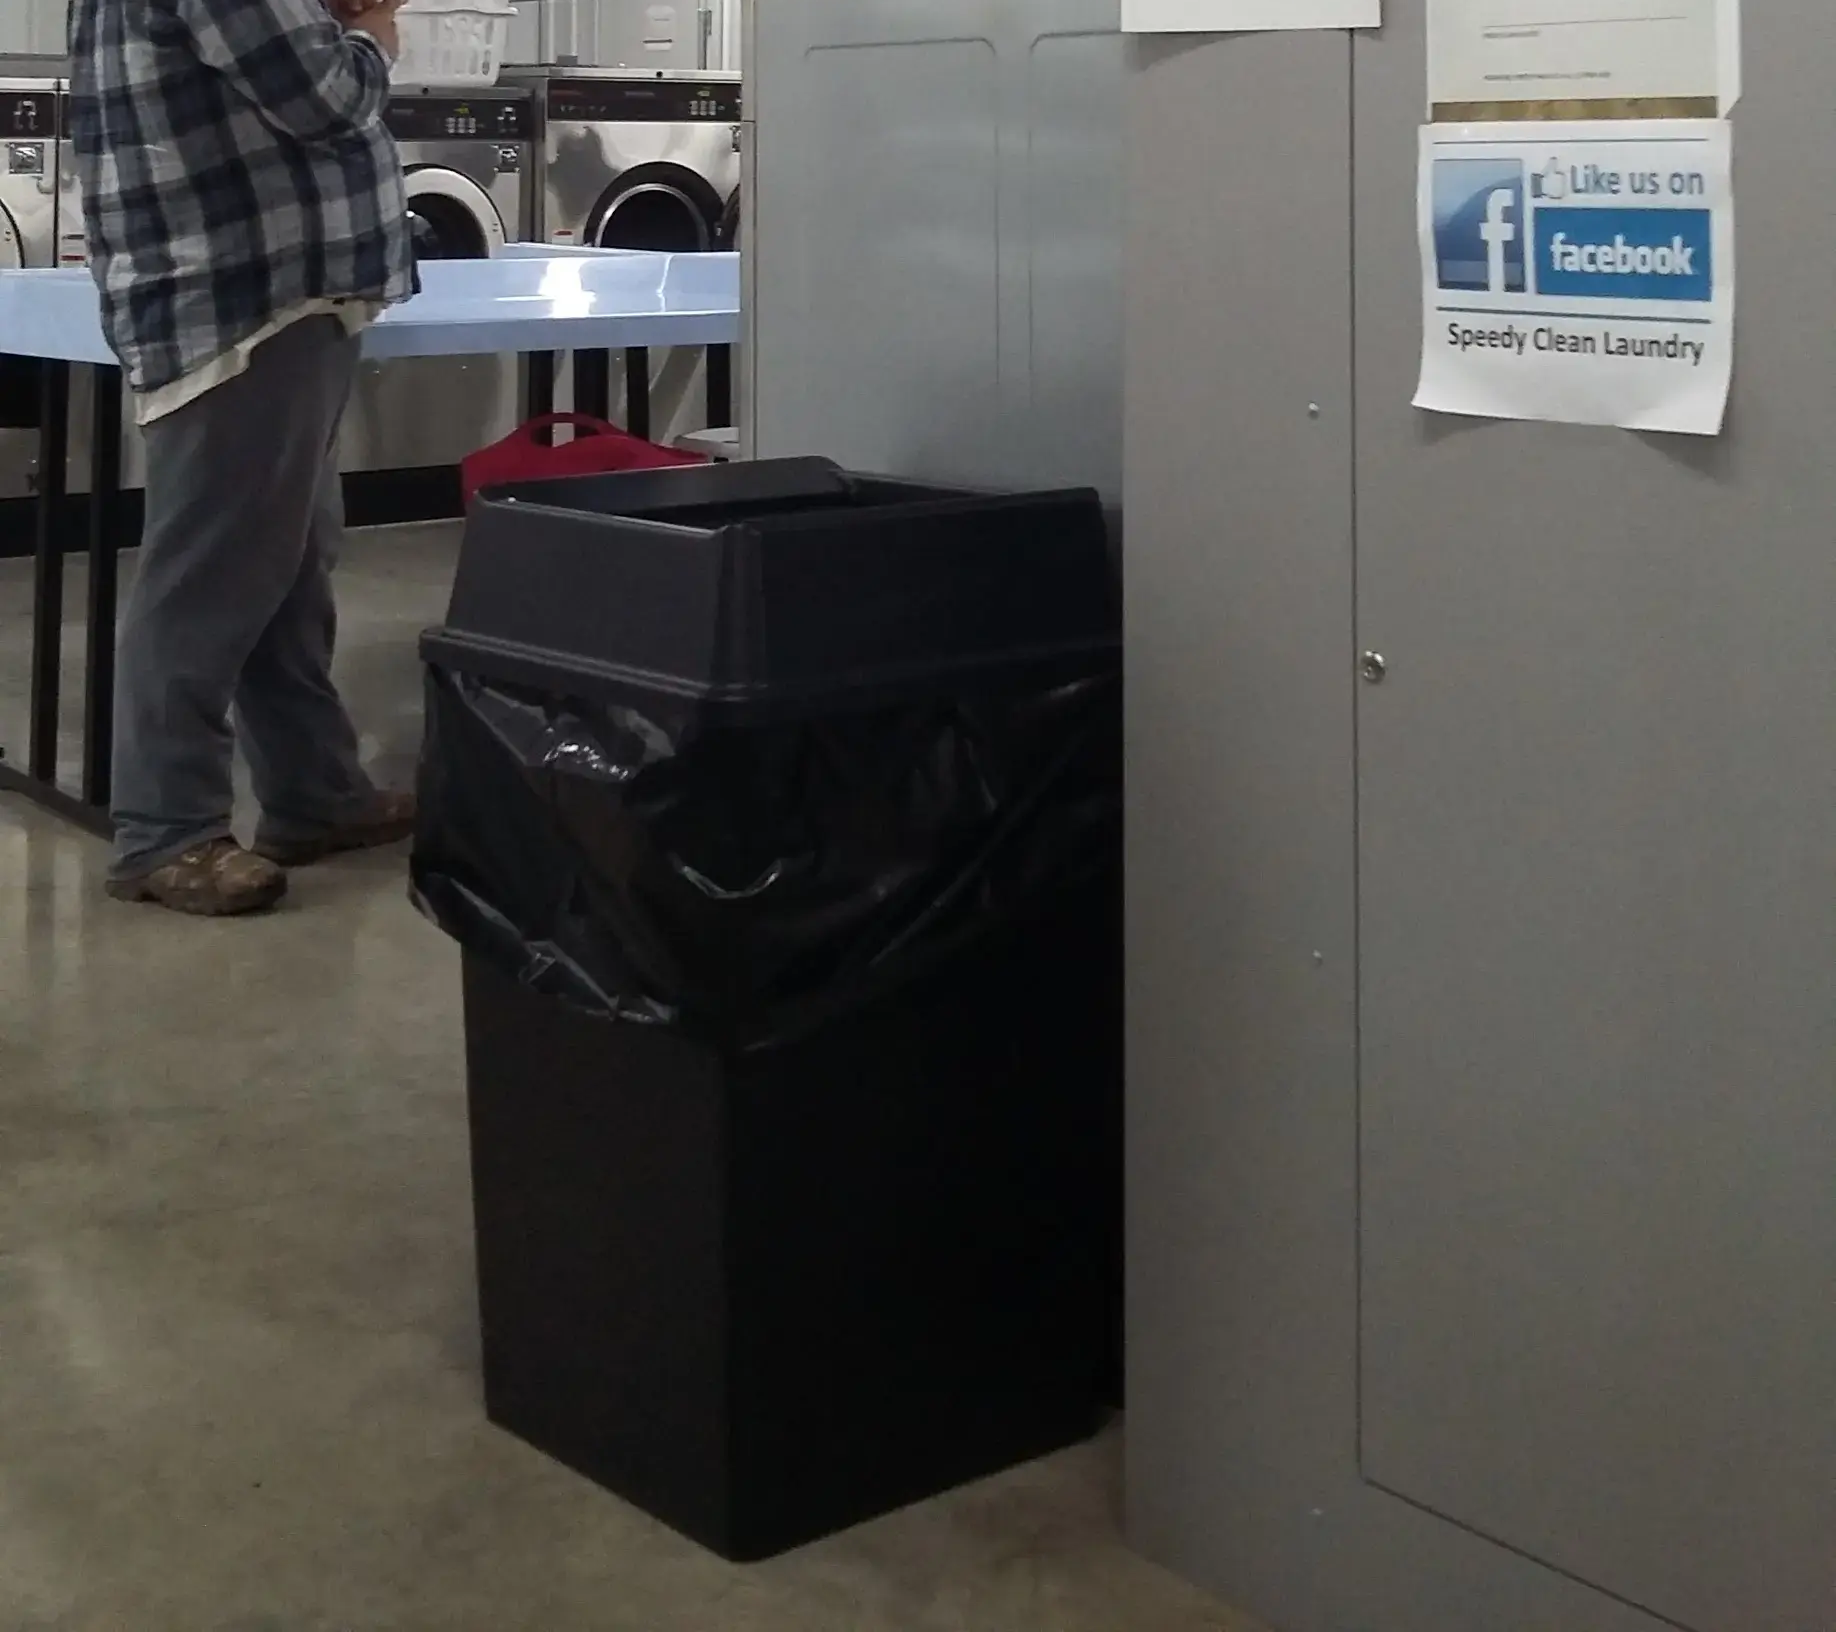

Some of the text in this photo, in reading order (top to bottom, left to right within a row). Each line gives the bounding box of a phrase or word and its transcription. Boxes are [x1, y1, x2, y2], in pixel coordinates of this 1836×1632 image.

[1570, 164, 1704, 195] Like us on
[1479, 188, 1515, 291] f
[1550, 232, 1695, 276] facebook
[1447, 322, 1705, 366] Speedy Clean Laundry
